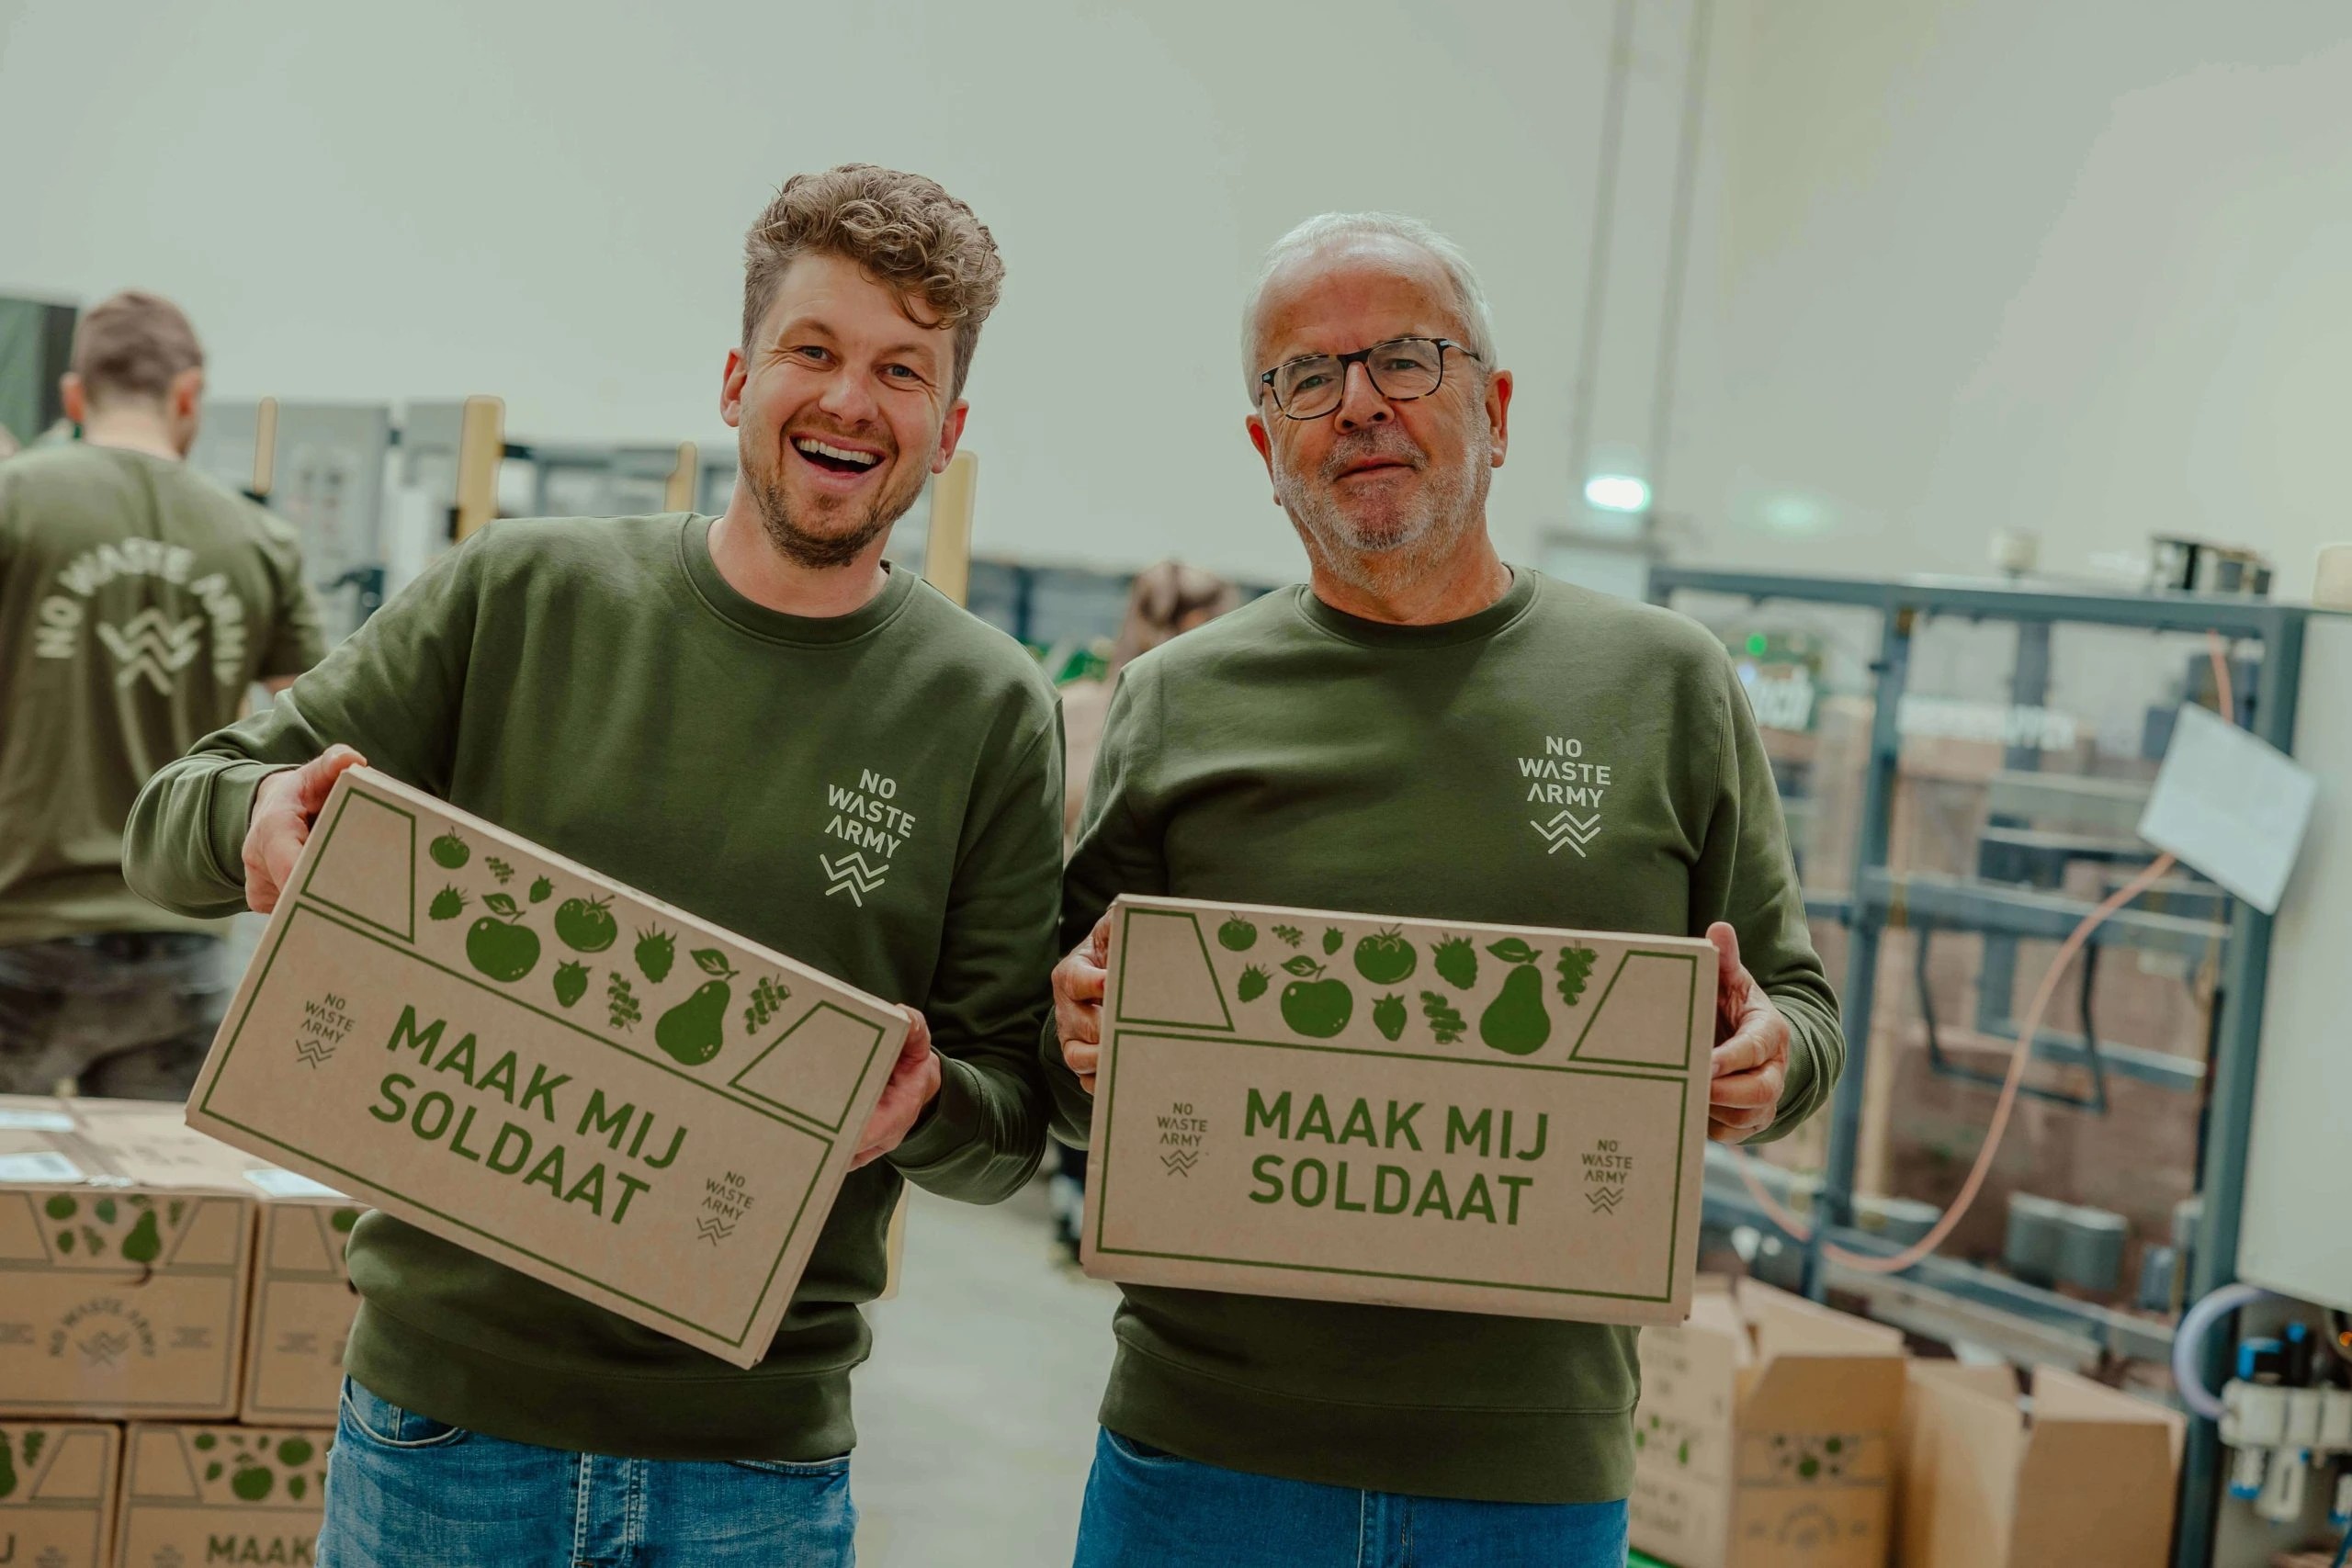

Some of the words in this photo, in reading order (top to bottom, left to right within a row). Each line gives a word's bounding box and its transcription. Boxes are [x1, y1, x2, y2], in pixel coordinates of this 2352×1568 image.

[1545, 735, 1582, 758] NO
[859, 768, 897, 799] NO
[1518, 757, 1611, 785] WASTE
[1527, 783, 1604, 808] ARMY
[829, 784, 916, 839] WASTE
[824, 814, 902, 859] ARMY
[324, 993, 346, 1010] NO
[305, 1000, 356, 1032] WASTE
[300, 1019, 345, 1043] ARMY
[386, 1004, 573, 1122] MAAK
[576, 1089, 688, 1169] MIJ
[1172, 1102, 1193, 1115] NO
[1157, 1116, 1208, 1133] WASTE
[1244, 1089, 1426, 1152] MAAK
[1444, 1105, 1548, 1161] MIJ
[368, 1073, 651, 1225] SOLDAAT
[1159, 1133, 1202, 1146] ARMY
[1597, 1139, 1618, 1153] NO
[1581, 1153, 1633, 1169] WASTE
[724, 1170, 746, 1188] NO
[1583, 1169, 1628, 1184] ARMY
[706, 1178, 755, 1210] WASTE
[1249, 1155, 1533, 1225] SOLDAAT
[701, 1196, 744, 1221] ARMY
[208, 1534, 316, 1564] MAAK
